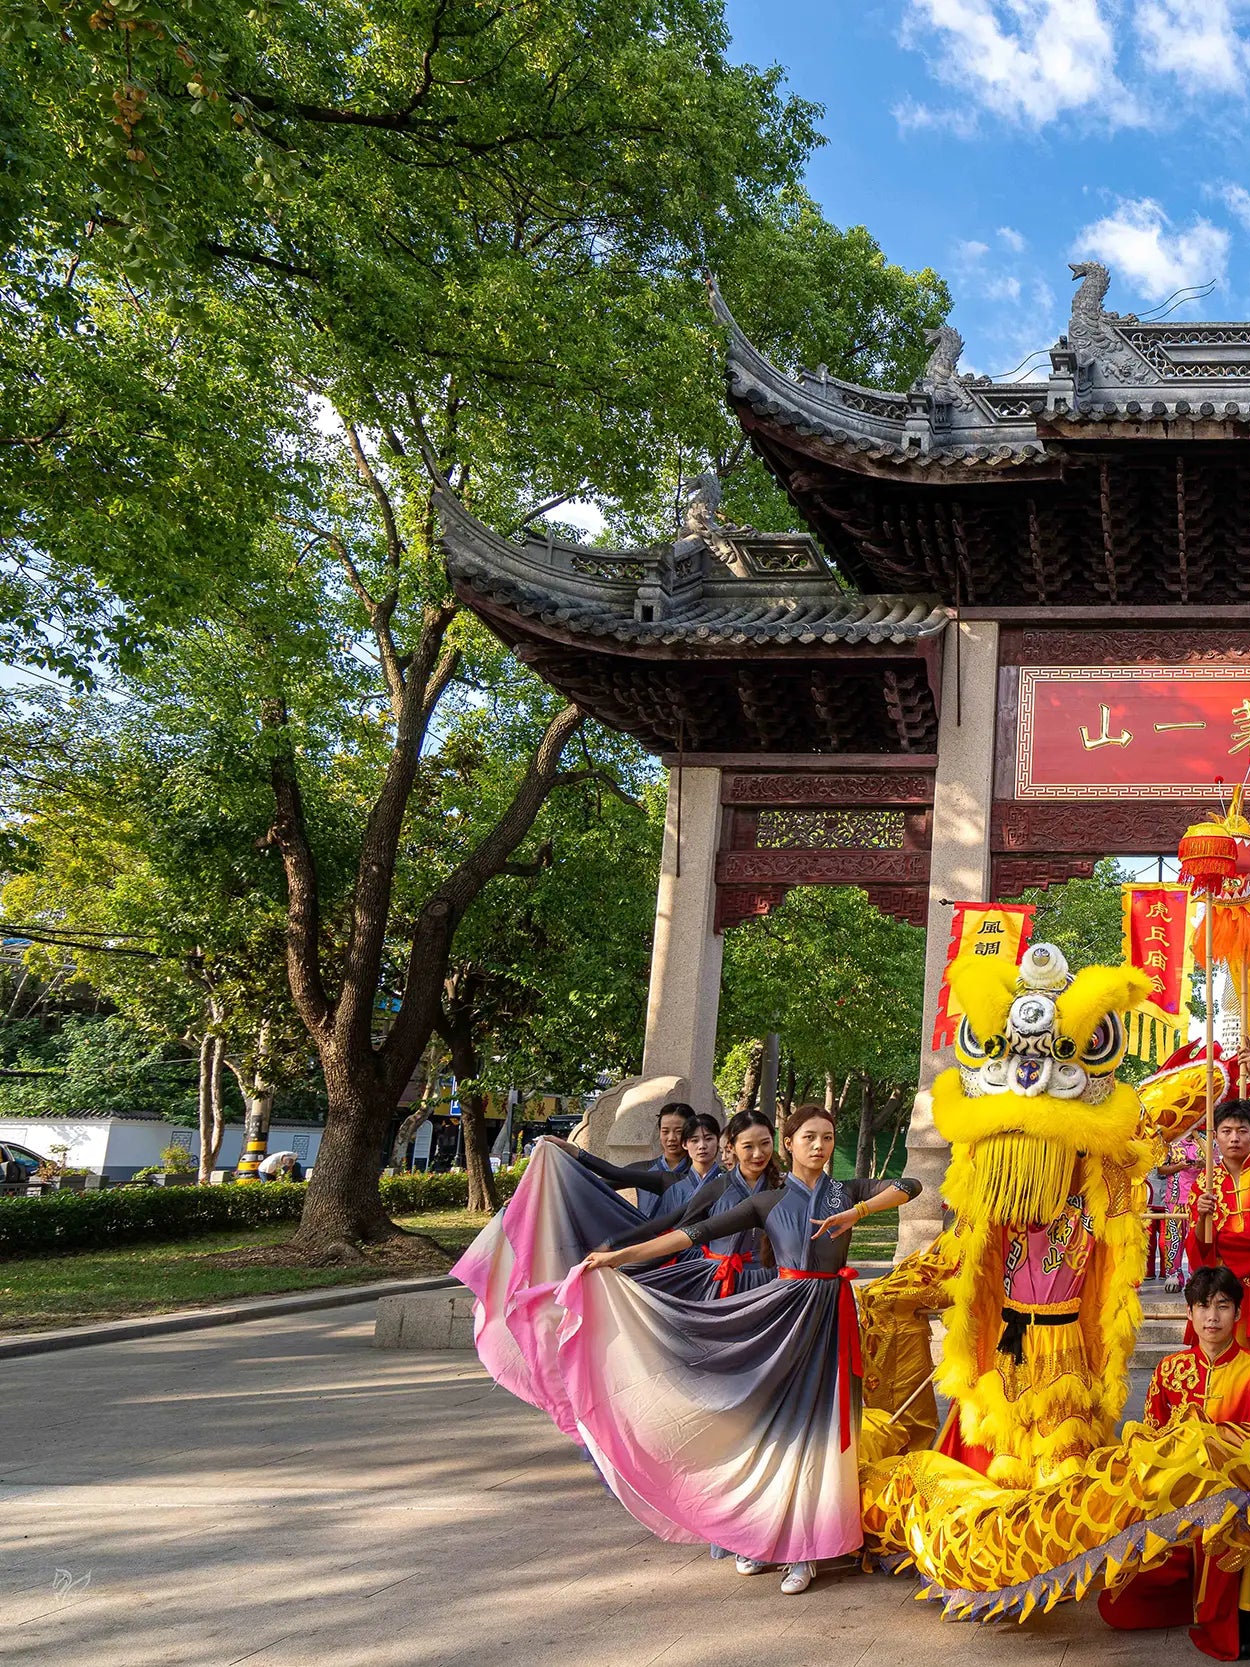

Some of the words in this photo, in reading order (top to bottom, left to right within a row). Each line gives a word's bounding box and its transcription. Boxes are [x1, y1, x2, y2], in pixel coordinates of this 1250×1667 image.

[974, 920, 1005, 956] 風調
[1143, 901, 1173, 995] 虎丘庙会
[1043, 1211, 1073, 1275] 佛山
